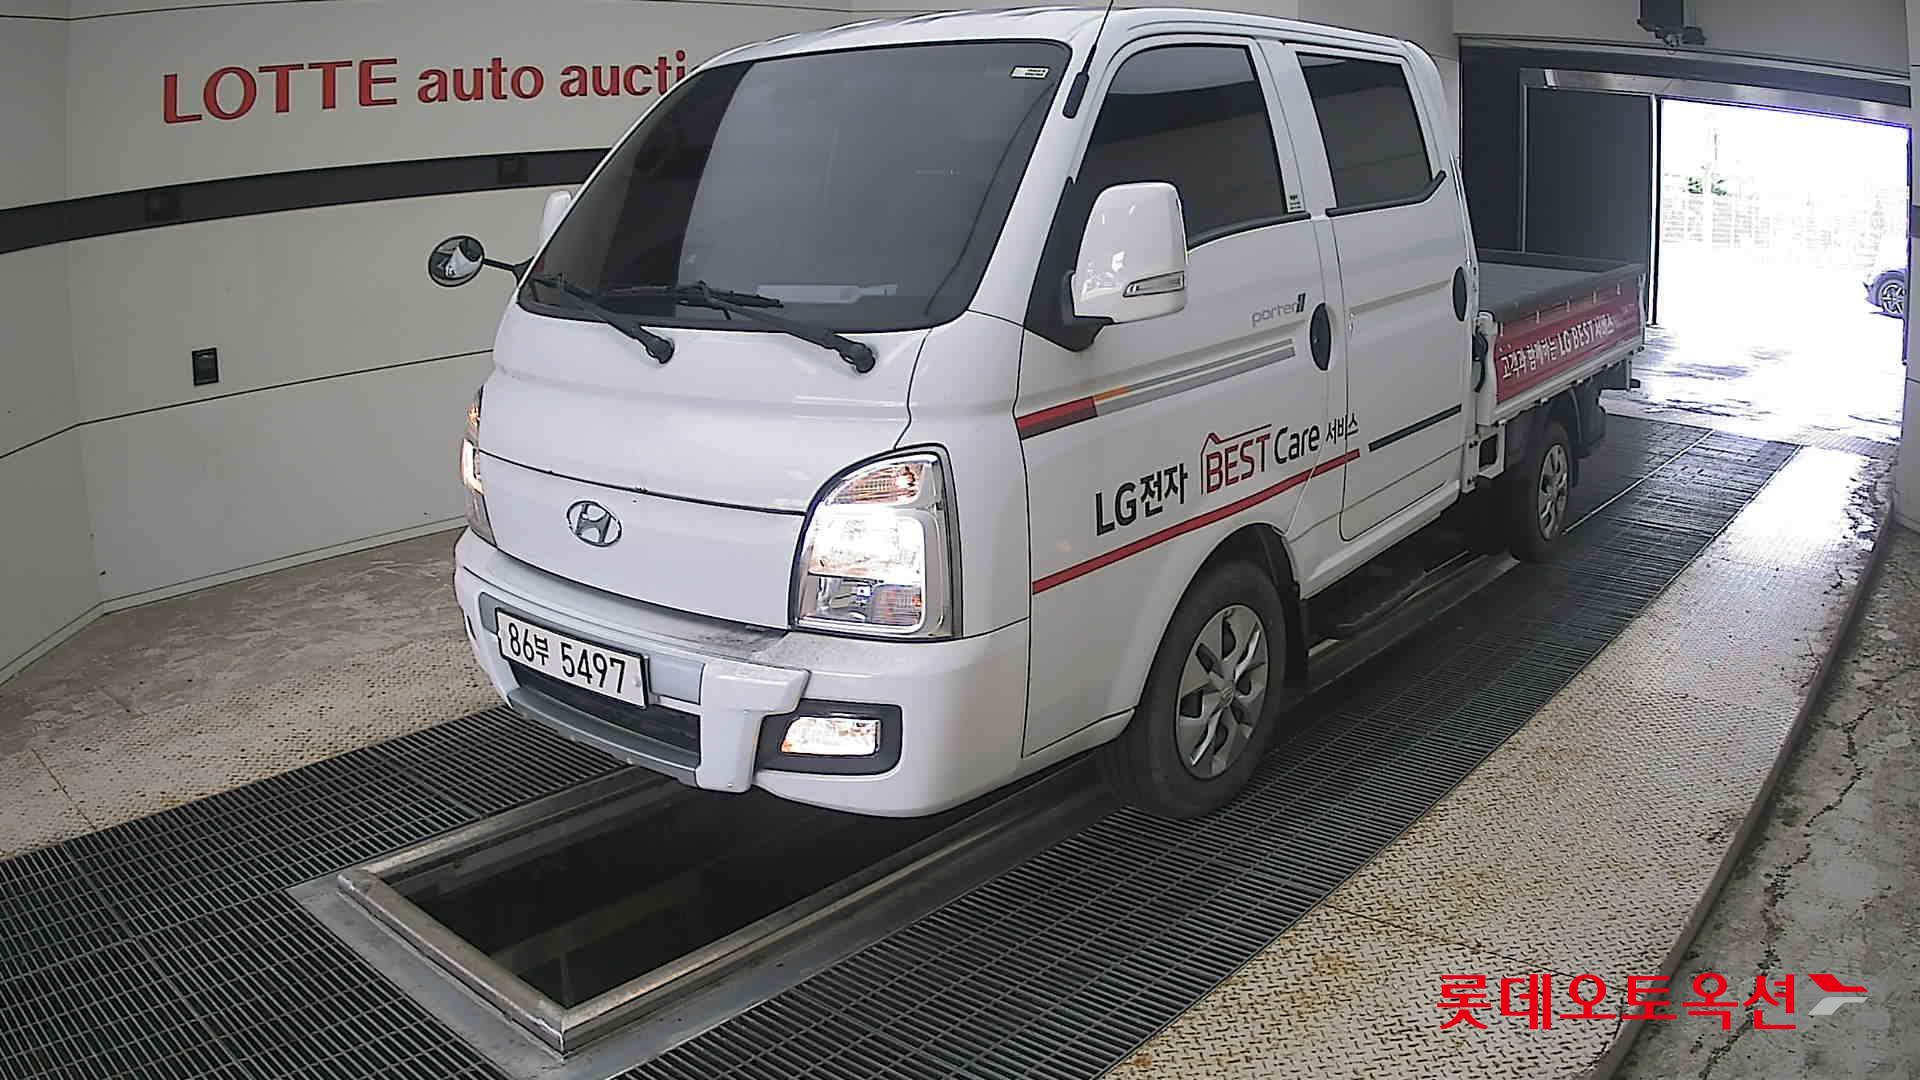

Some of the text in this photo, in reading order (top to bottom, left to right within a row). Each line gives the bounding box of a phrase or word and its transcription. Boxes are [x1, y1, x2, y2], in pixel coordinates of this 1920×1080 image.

[163, 50, 687, 124] LOTTE auto aucti
[1558, 330, 1572, 356] LG
[1096, 412, 1359, 536] LG전자 BEST Care 서비스
[508, 622, 626, 693] 86부 5497
